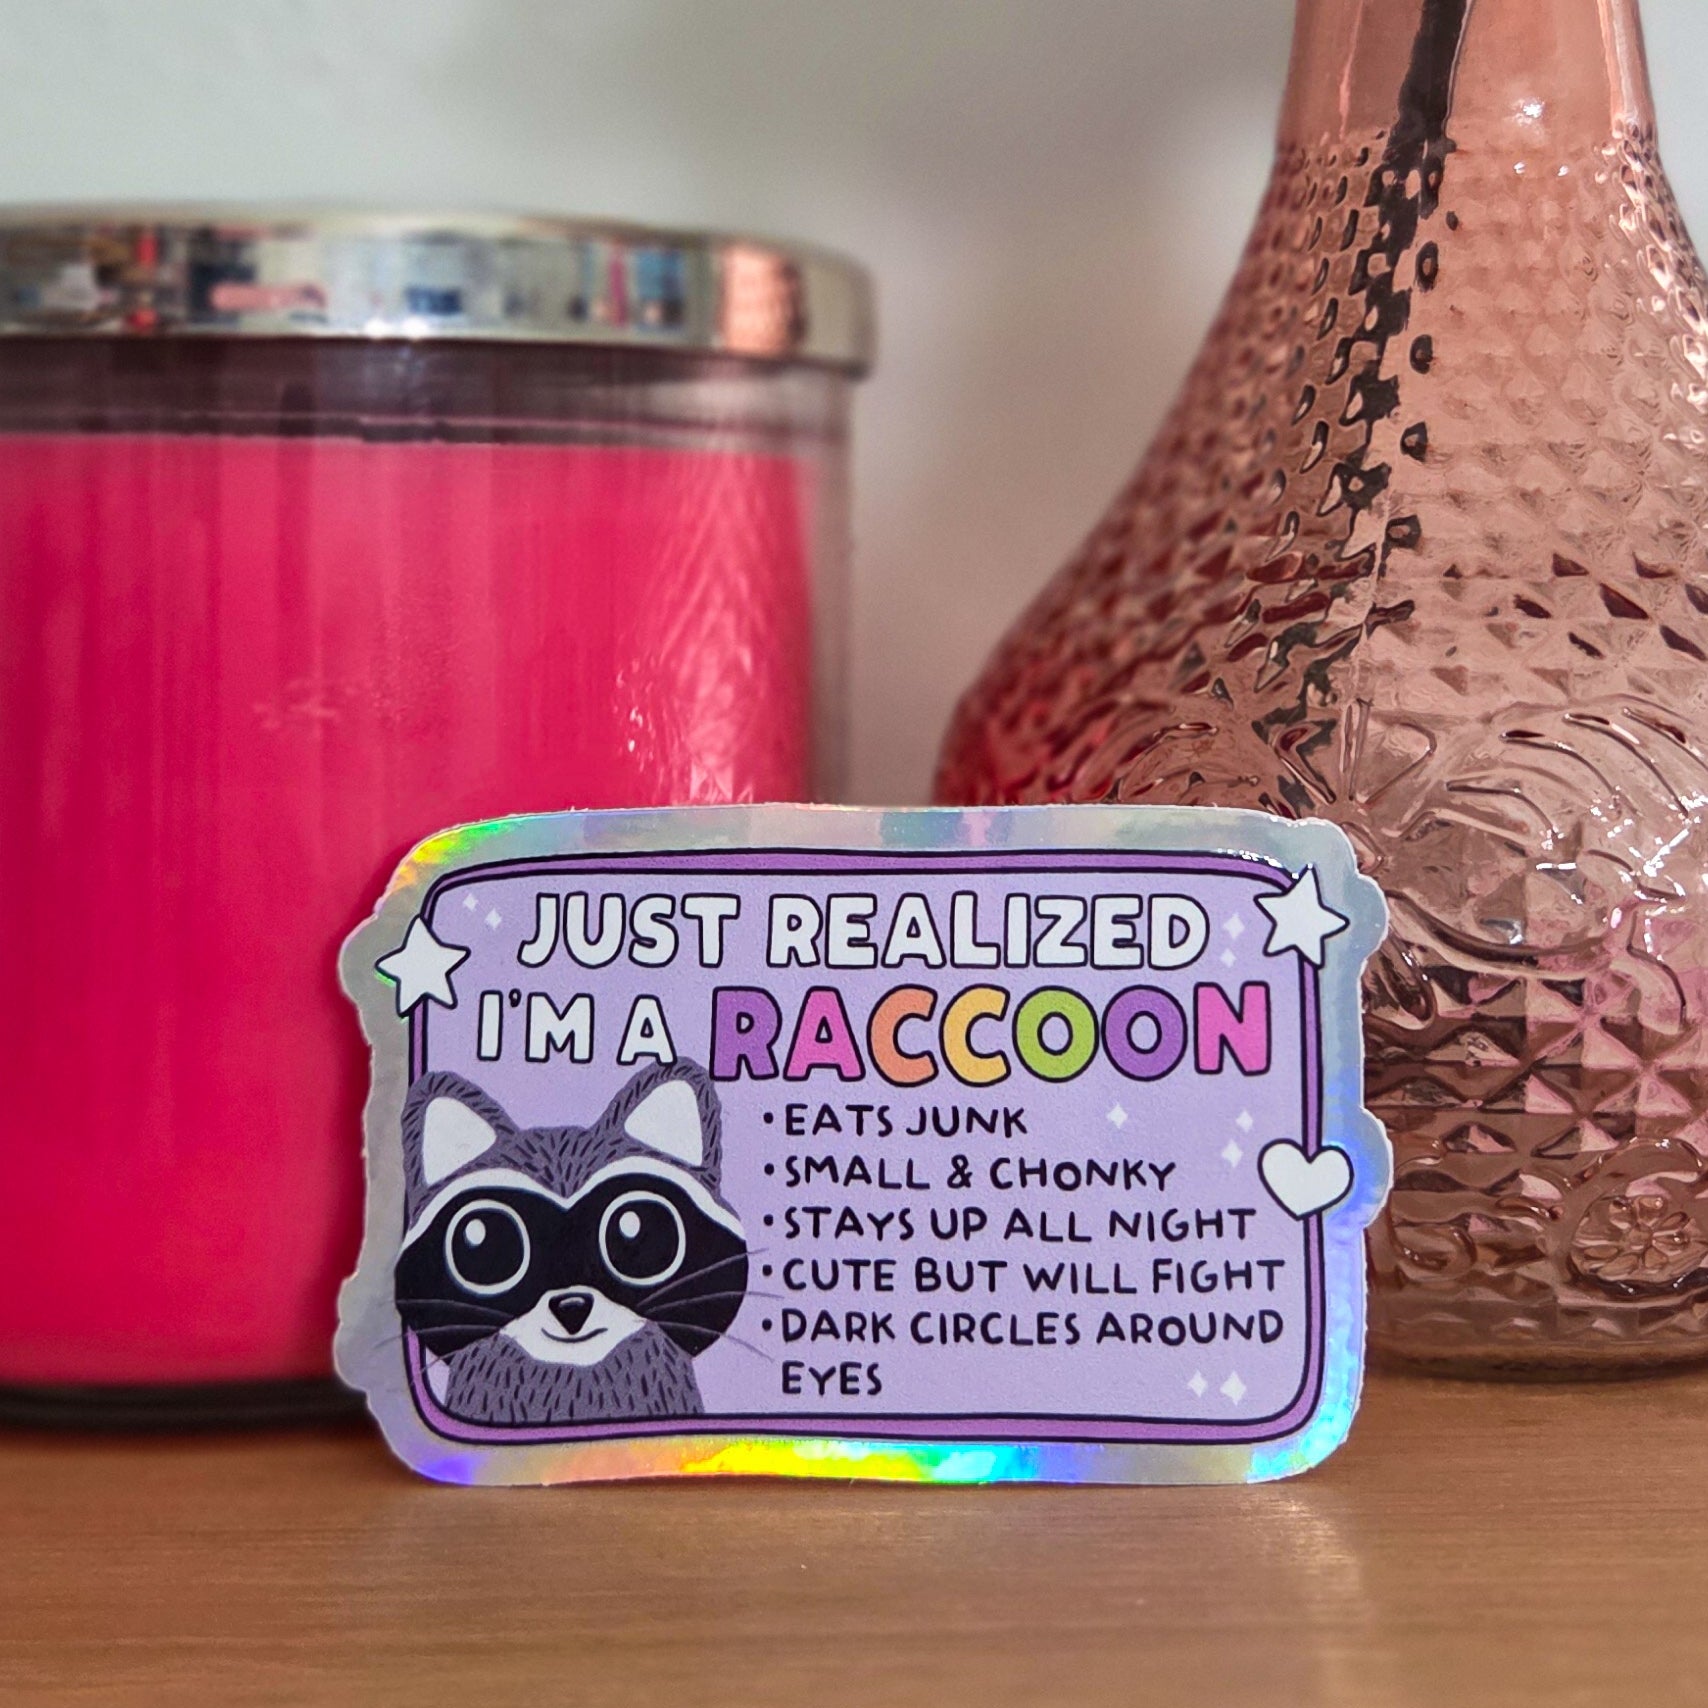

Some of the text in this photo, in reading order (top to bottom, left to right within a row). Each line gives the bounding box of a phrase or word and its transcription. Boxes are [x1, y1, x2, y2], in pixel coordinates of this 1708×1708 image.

[516, 889, 1211, 972] JUST REALIZED
[476, 980, 1273, 1088] I'M A RACCOON
[785, 1103, 1028, 1139] EATS JUNK
[785, 1154, 1176, 1192] SMALL & CHONKY
[784, 1205, 1257, 1243] STAYS UP ALL NIGHT
[782, 1256, 1286, 1295] CUTE BUT WILL FIGHT
[781, 1307, 1284, 1347] DARK CIRCLES AROUND
[781, 1360, 883, 1397] EYES
